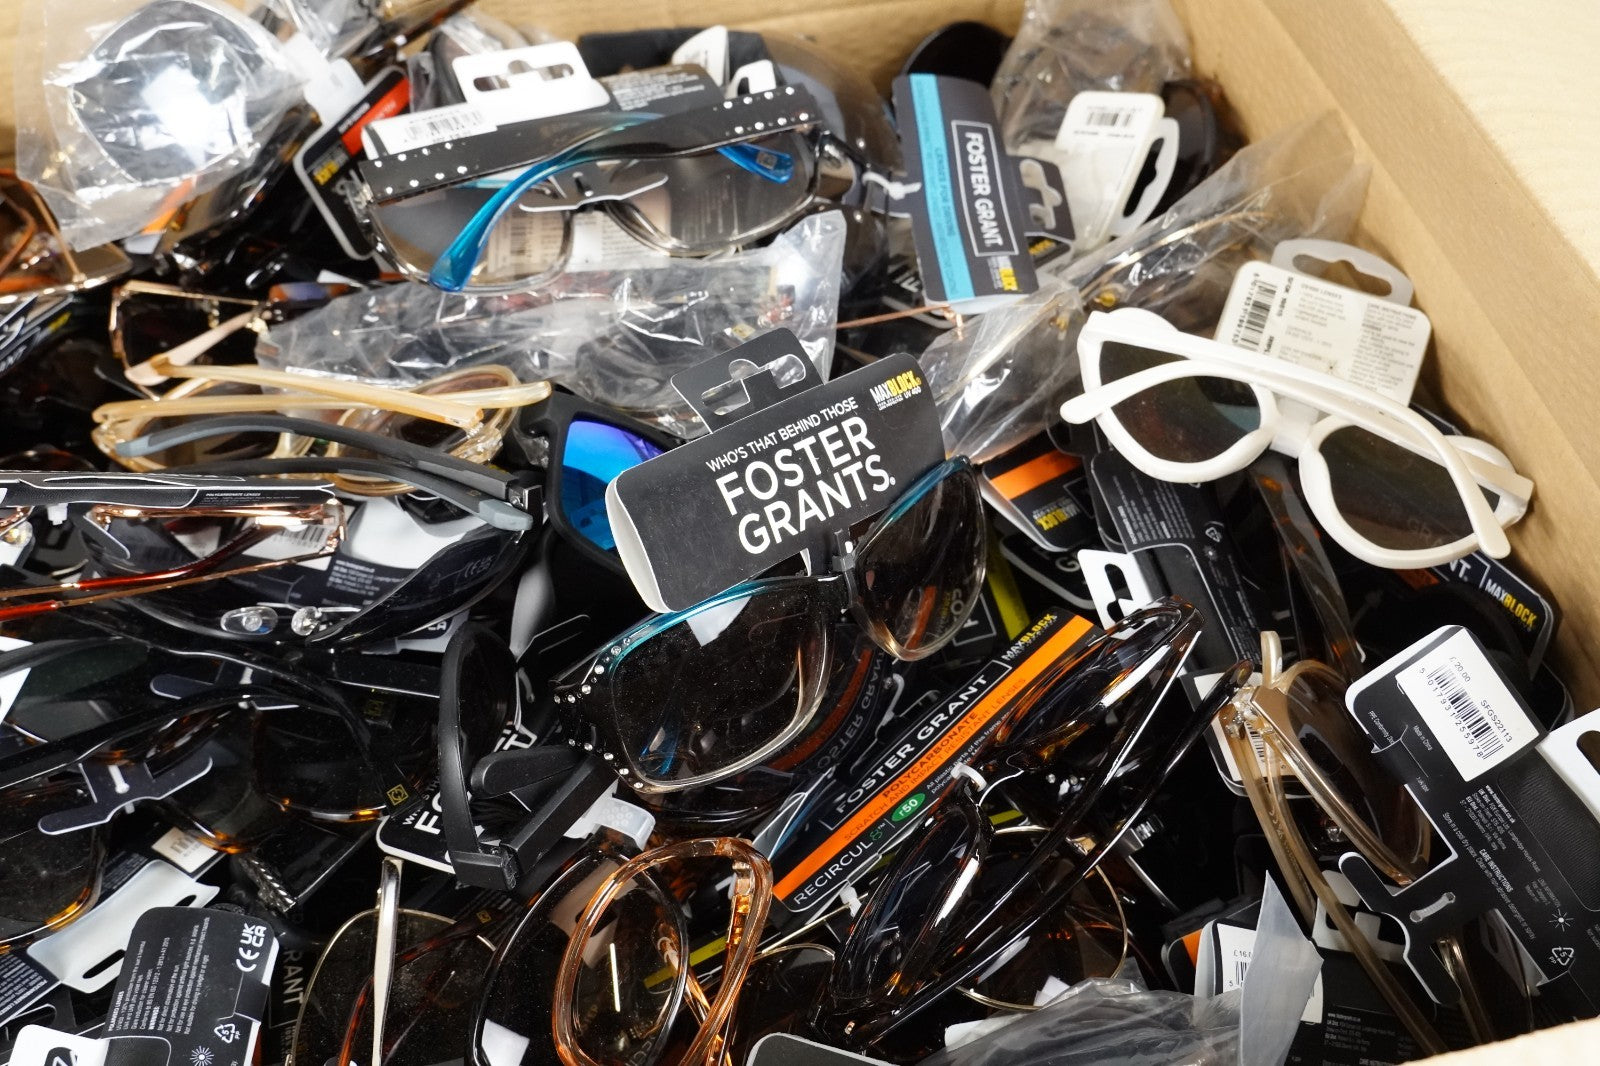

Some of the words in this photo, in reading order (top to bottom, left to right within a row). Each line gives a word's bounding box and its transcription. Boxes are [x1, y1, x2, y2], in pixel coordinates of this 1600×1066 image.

[966, 133, 991, 195] FOSTER
[706, 447, 748, 472] WHO'S
[746, 432, 777, 453] THAT
[778, 414, 820, 440] BEHIND
[820, 397, 858, 420] THOSE
[716, 417, 875, 515] FOSTER
[1482, 578, 1538, 627] MAXBLOCK
[1452, 660, 1472, 684] 20.00
[837, 744, 914, 812] FOSTER
[917, 675, 986, 740] GRANT
[1478, 697, 1513, 744] SFGS22113
[842, 800, 888, 843] SCRATCH
[885, 779, 911, 805] AND
[908, 747, 947, 784] IMPACT
[943, 707, 992, 753] RESISTANT
[989, 675, 1028, 712] LENSES
[881, 710, 979, 800] POLYCARBONATE
[932, 763, 955, 785] plastic
[951, 749, 970, 768] parts
[899, 799, 918, 816] r50
[1477, 847, 1492, 863] CARE
[1486, 859, 1514, 894] INSTRUCTIONS
[279, 946, 303, 1008] RANT
[233, 1029, 242, 1040] PP
